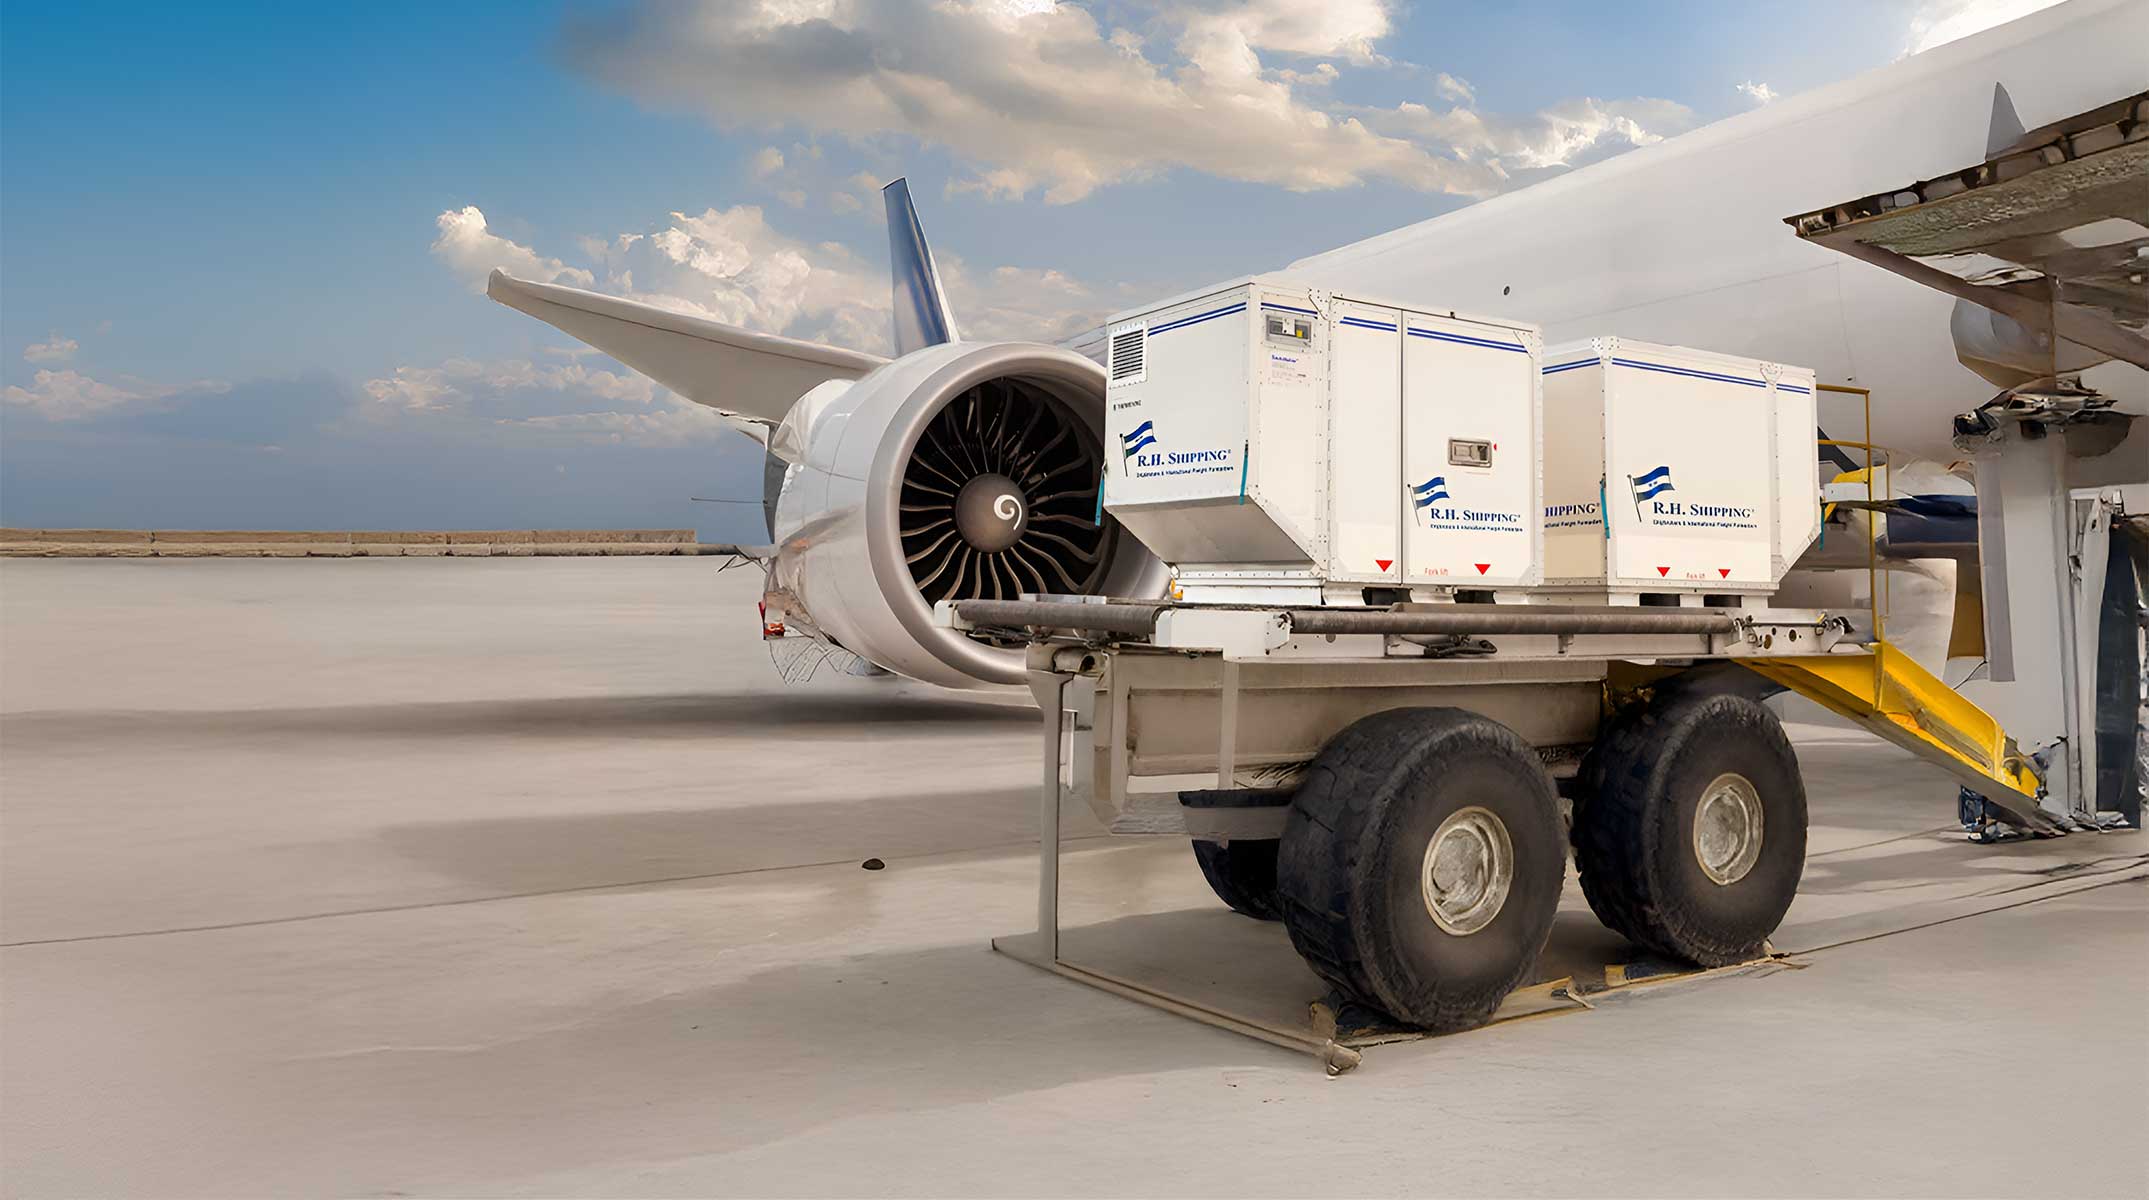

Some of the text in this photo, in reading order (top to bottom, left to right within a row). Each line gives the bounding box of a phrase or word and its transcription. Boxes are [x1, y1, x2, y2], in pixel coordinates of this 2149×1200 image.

[1137, 453, 1165, 467] R.H.
[1430, 508, 1459, 520] R.H.
[1653, 501, 1686, 515] R.H.
